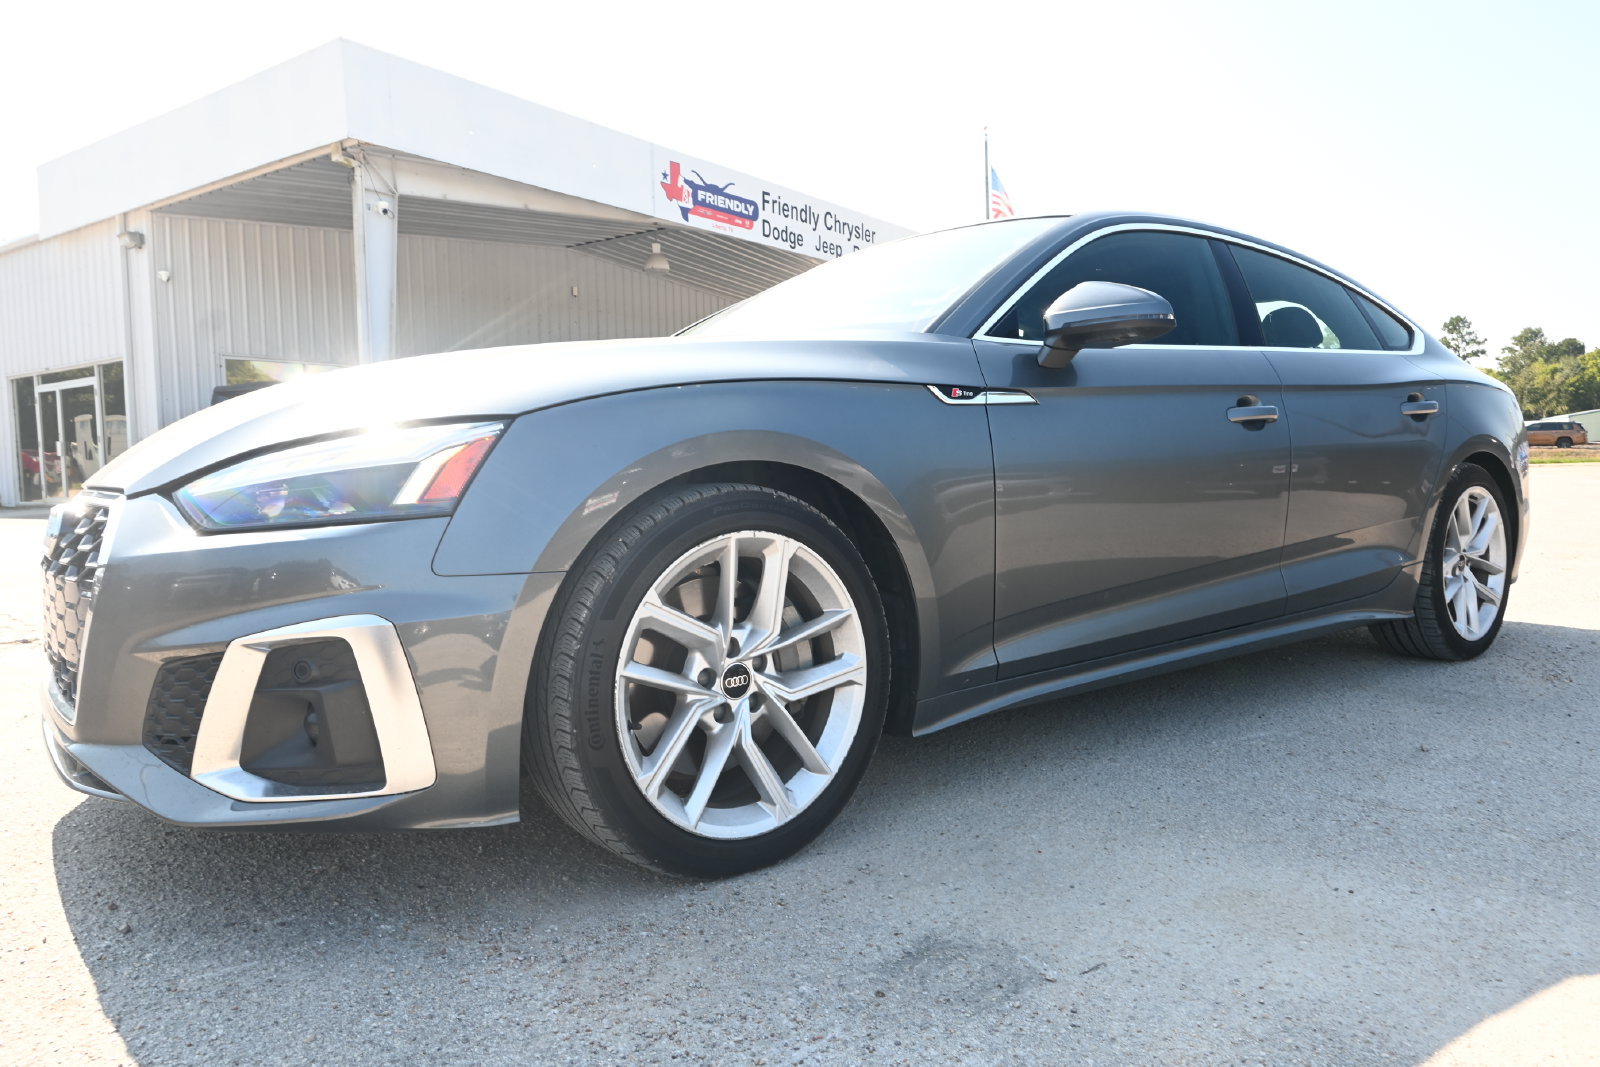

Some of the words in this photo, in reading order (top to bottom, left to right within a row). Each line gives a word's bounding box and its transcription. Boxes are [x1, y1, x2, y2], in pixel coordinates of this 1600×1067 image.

[697, 189, 756, 216] FRIENDLY
[761, 190, 820, 231] Friendly
[823, 211, 876, 243] Chrysler
[761, 219, 804, 249] Dodge
[815, 235, 843, 258] Jeep
[584, 653, 606, 751] Continental
